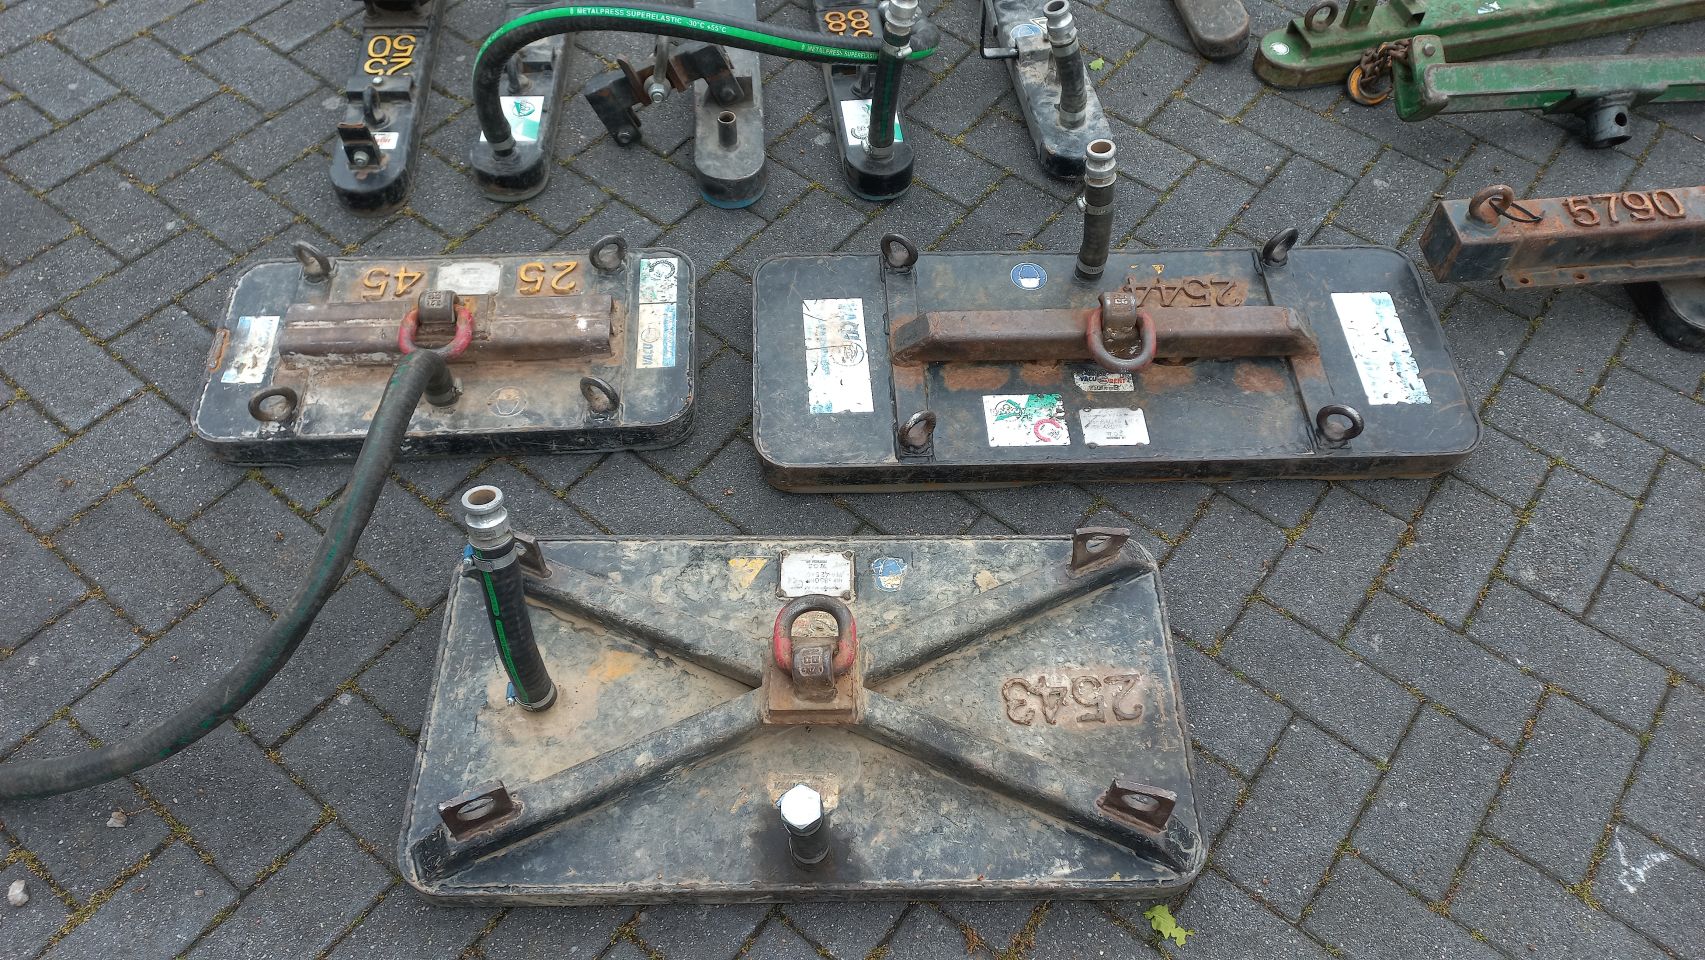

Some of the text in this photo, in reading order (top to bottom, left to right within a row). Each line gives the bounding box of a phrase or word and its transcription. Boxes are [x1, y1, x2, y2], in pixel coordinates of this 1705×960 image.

[576, 7, 727, 33] METALPRESS SUPERELASTIC -30°C +55°C
[367, 34, 417, 58] 50
[807, 44, 878, 60] METALPRESS SUPERELASTI
[1562, 190, 1687, 227] 5790
[361, 266, 424, 299] 45
[516, 260, 578, 294] 25
[1001, 673, 1143, 727] 2543
